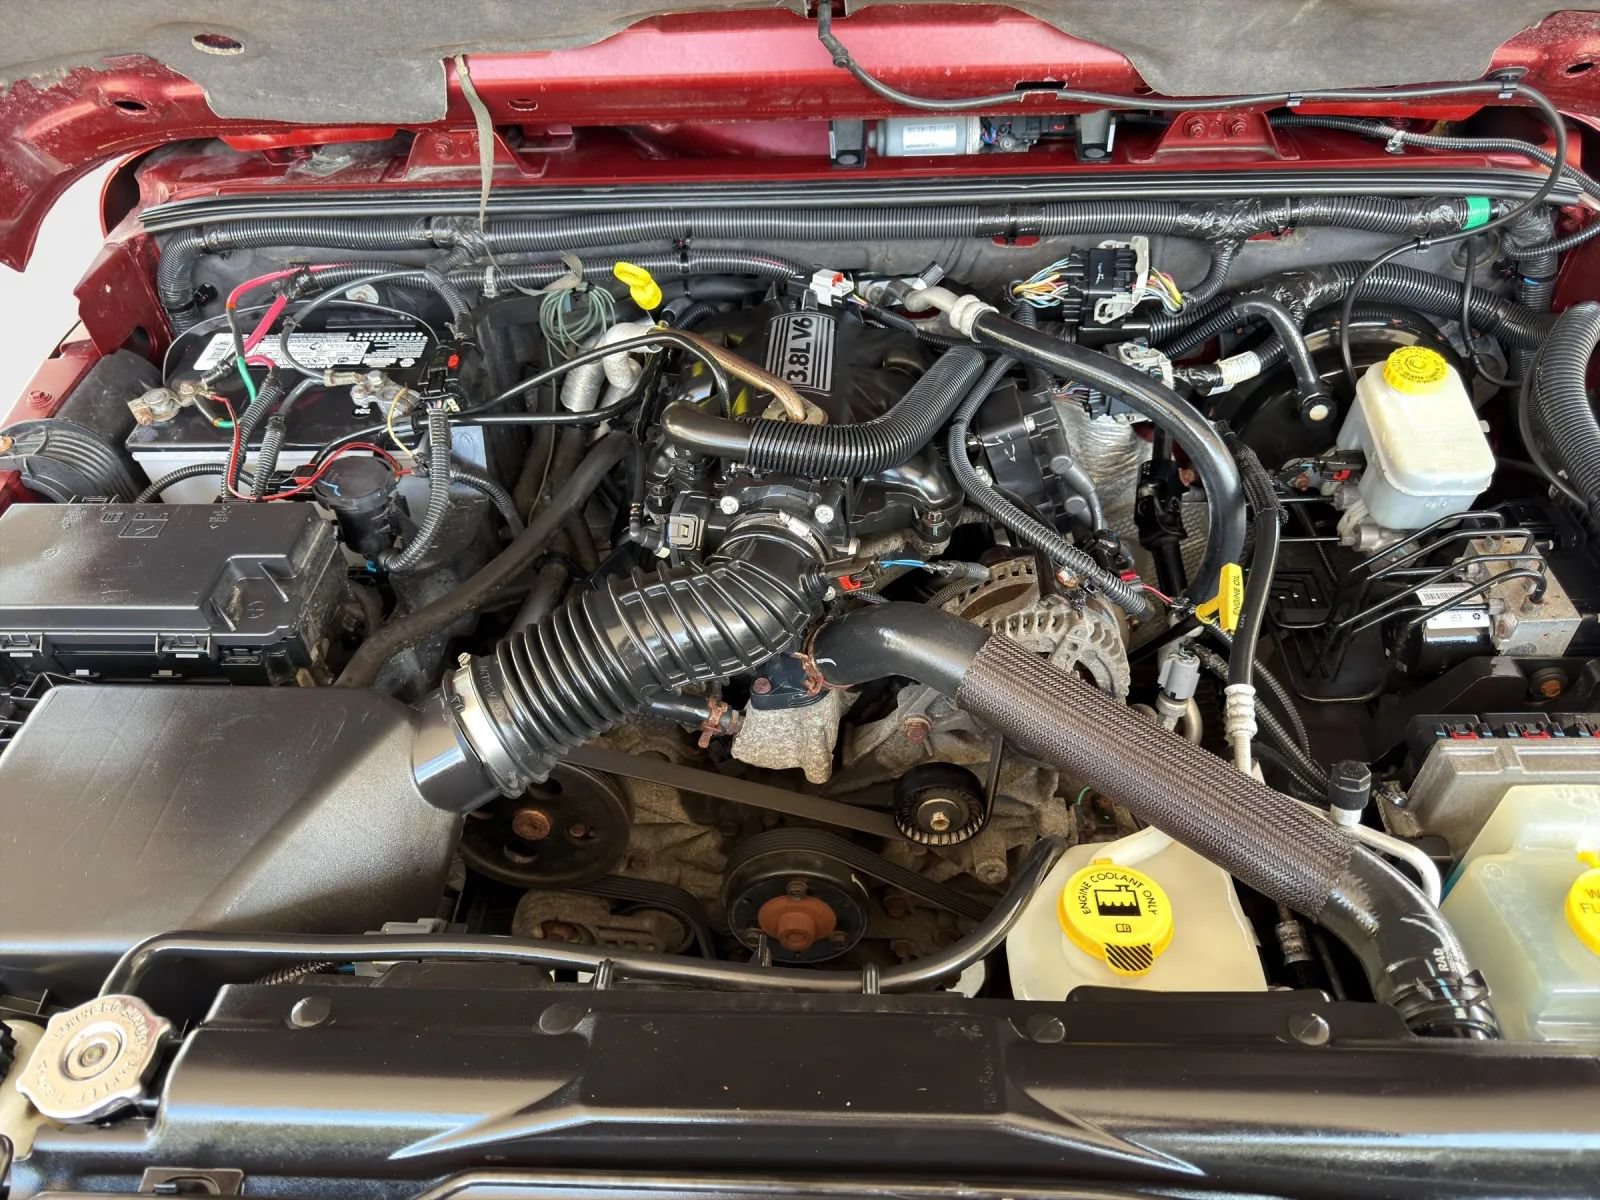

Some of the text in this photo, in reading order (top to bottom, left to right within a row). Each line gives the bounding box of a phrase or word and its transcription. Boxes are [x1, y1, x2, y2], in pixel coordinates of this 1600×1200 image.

[786, 317, 813, 383] 3.8L V6
[1232, 575, 1241, 616] ENGINE OIL
[1077, 872, 1158, 916] ENGINE COOLANT ONLY
[1433, 947, 1450, 972] RAD
